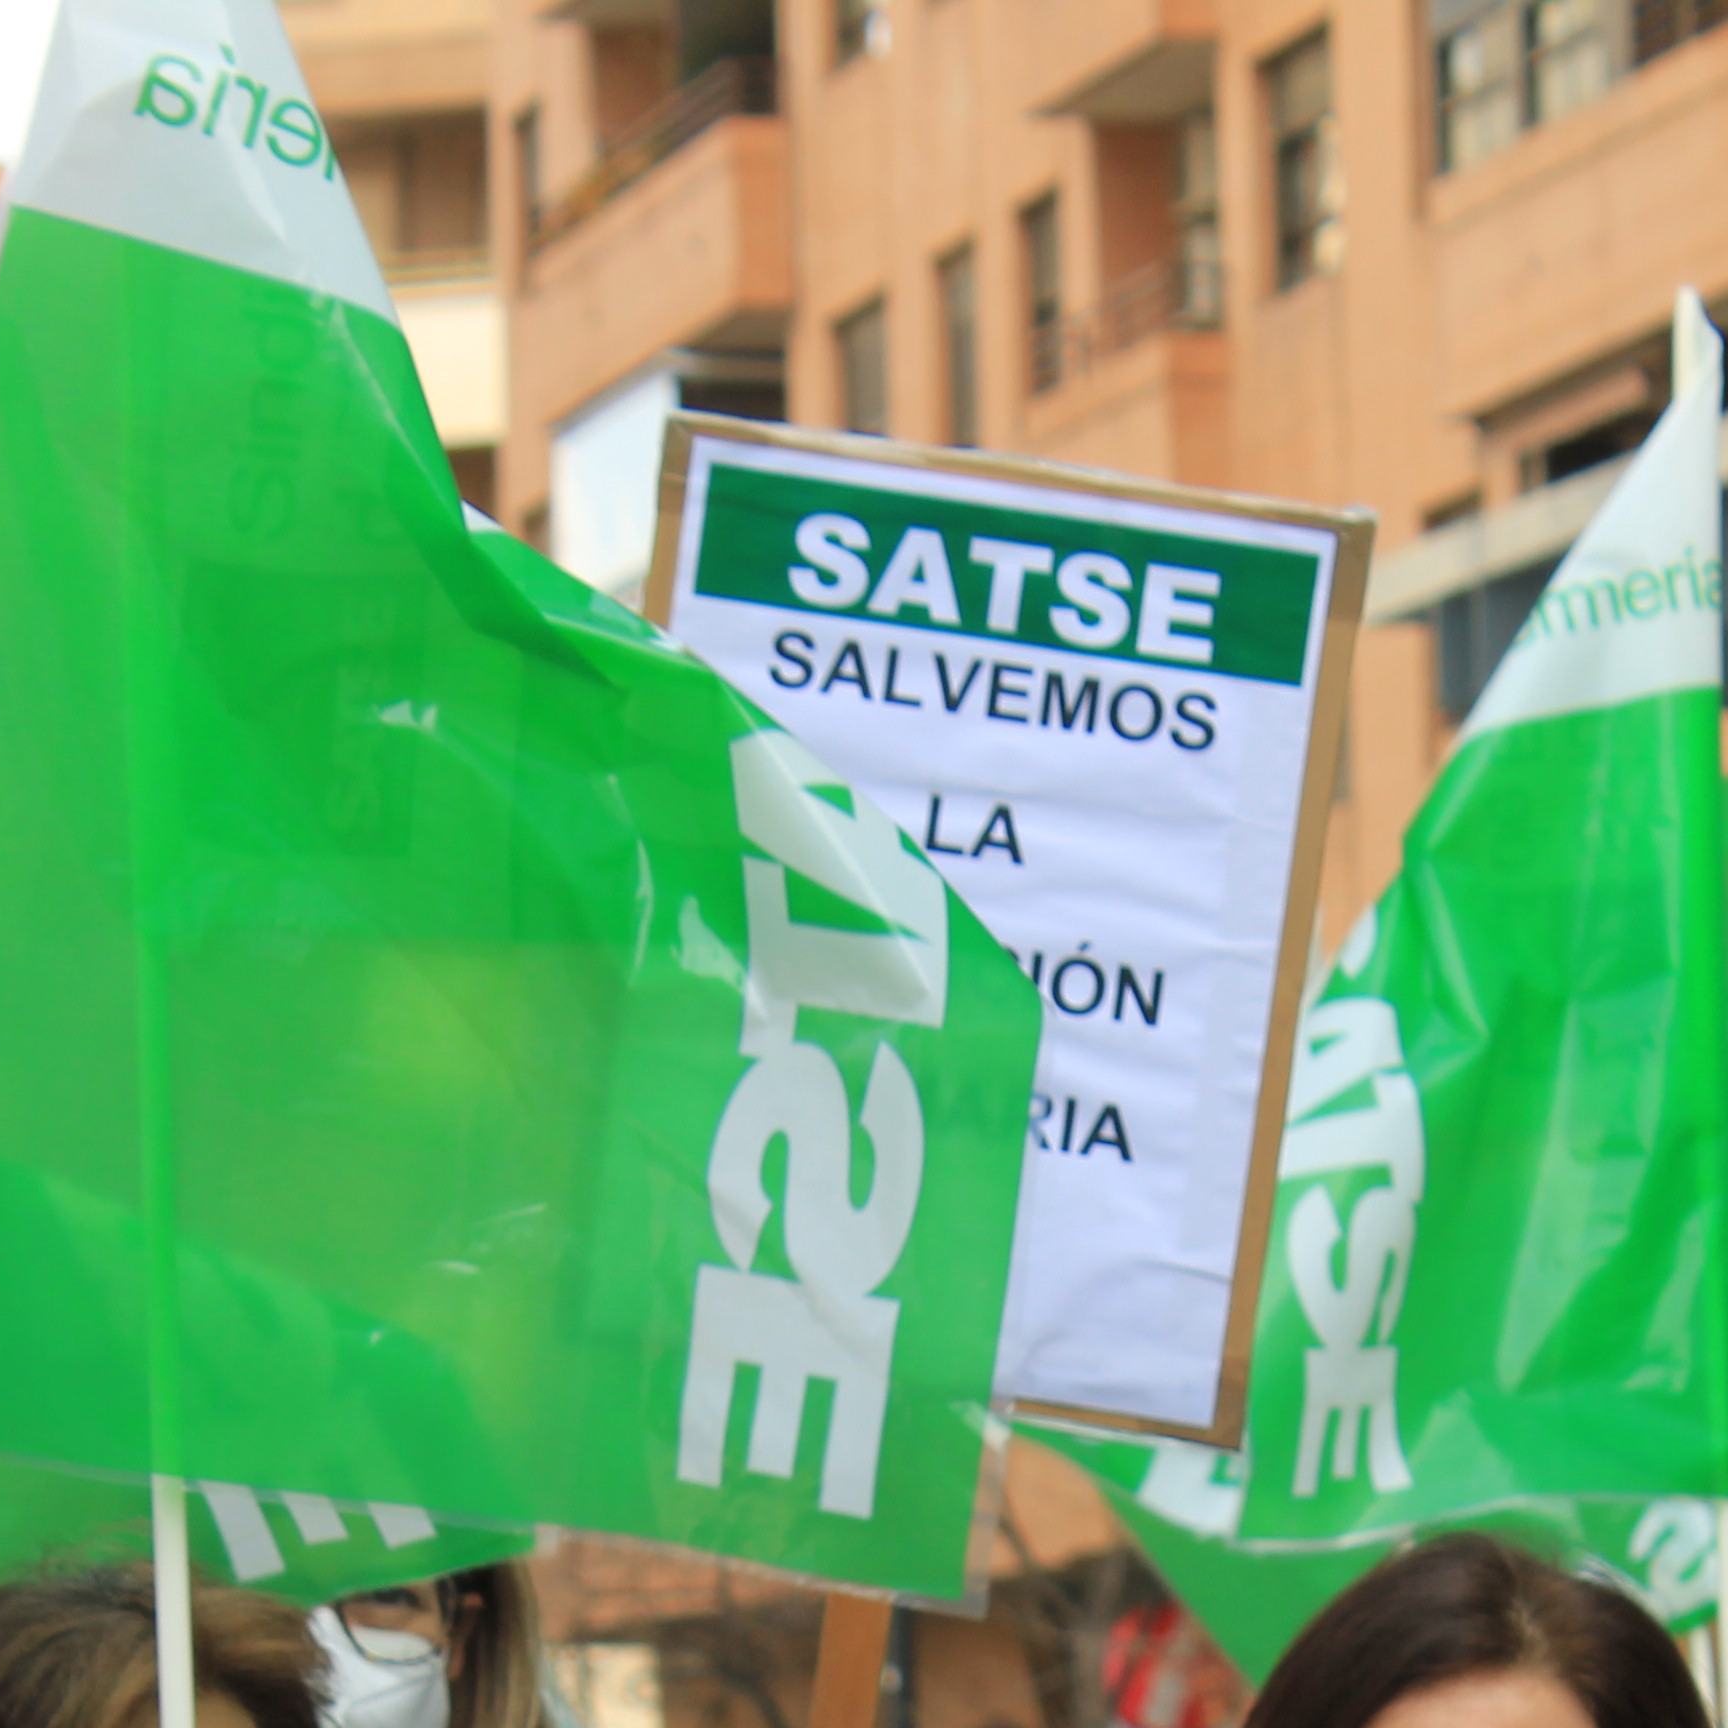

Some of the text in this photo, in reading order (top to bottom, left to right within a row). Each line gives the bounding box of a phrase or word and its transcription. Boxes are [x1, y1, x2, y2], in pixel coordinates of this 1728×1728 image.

[787, 511, 1221, 665] SATSE
[769, 629, 1218, 753] SALVEMOS
[924, 796, 1025, 866] LA
[1003, 938, 1165, 1026] IÓN
